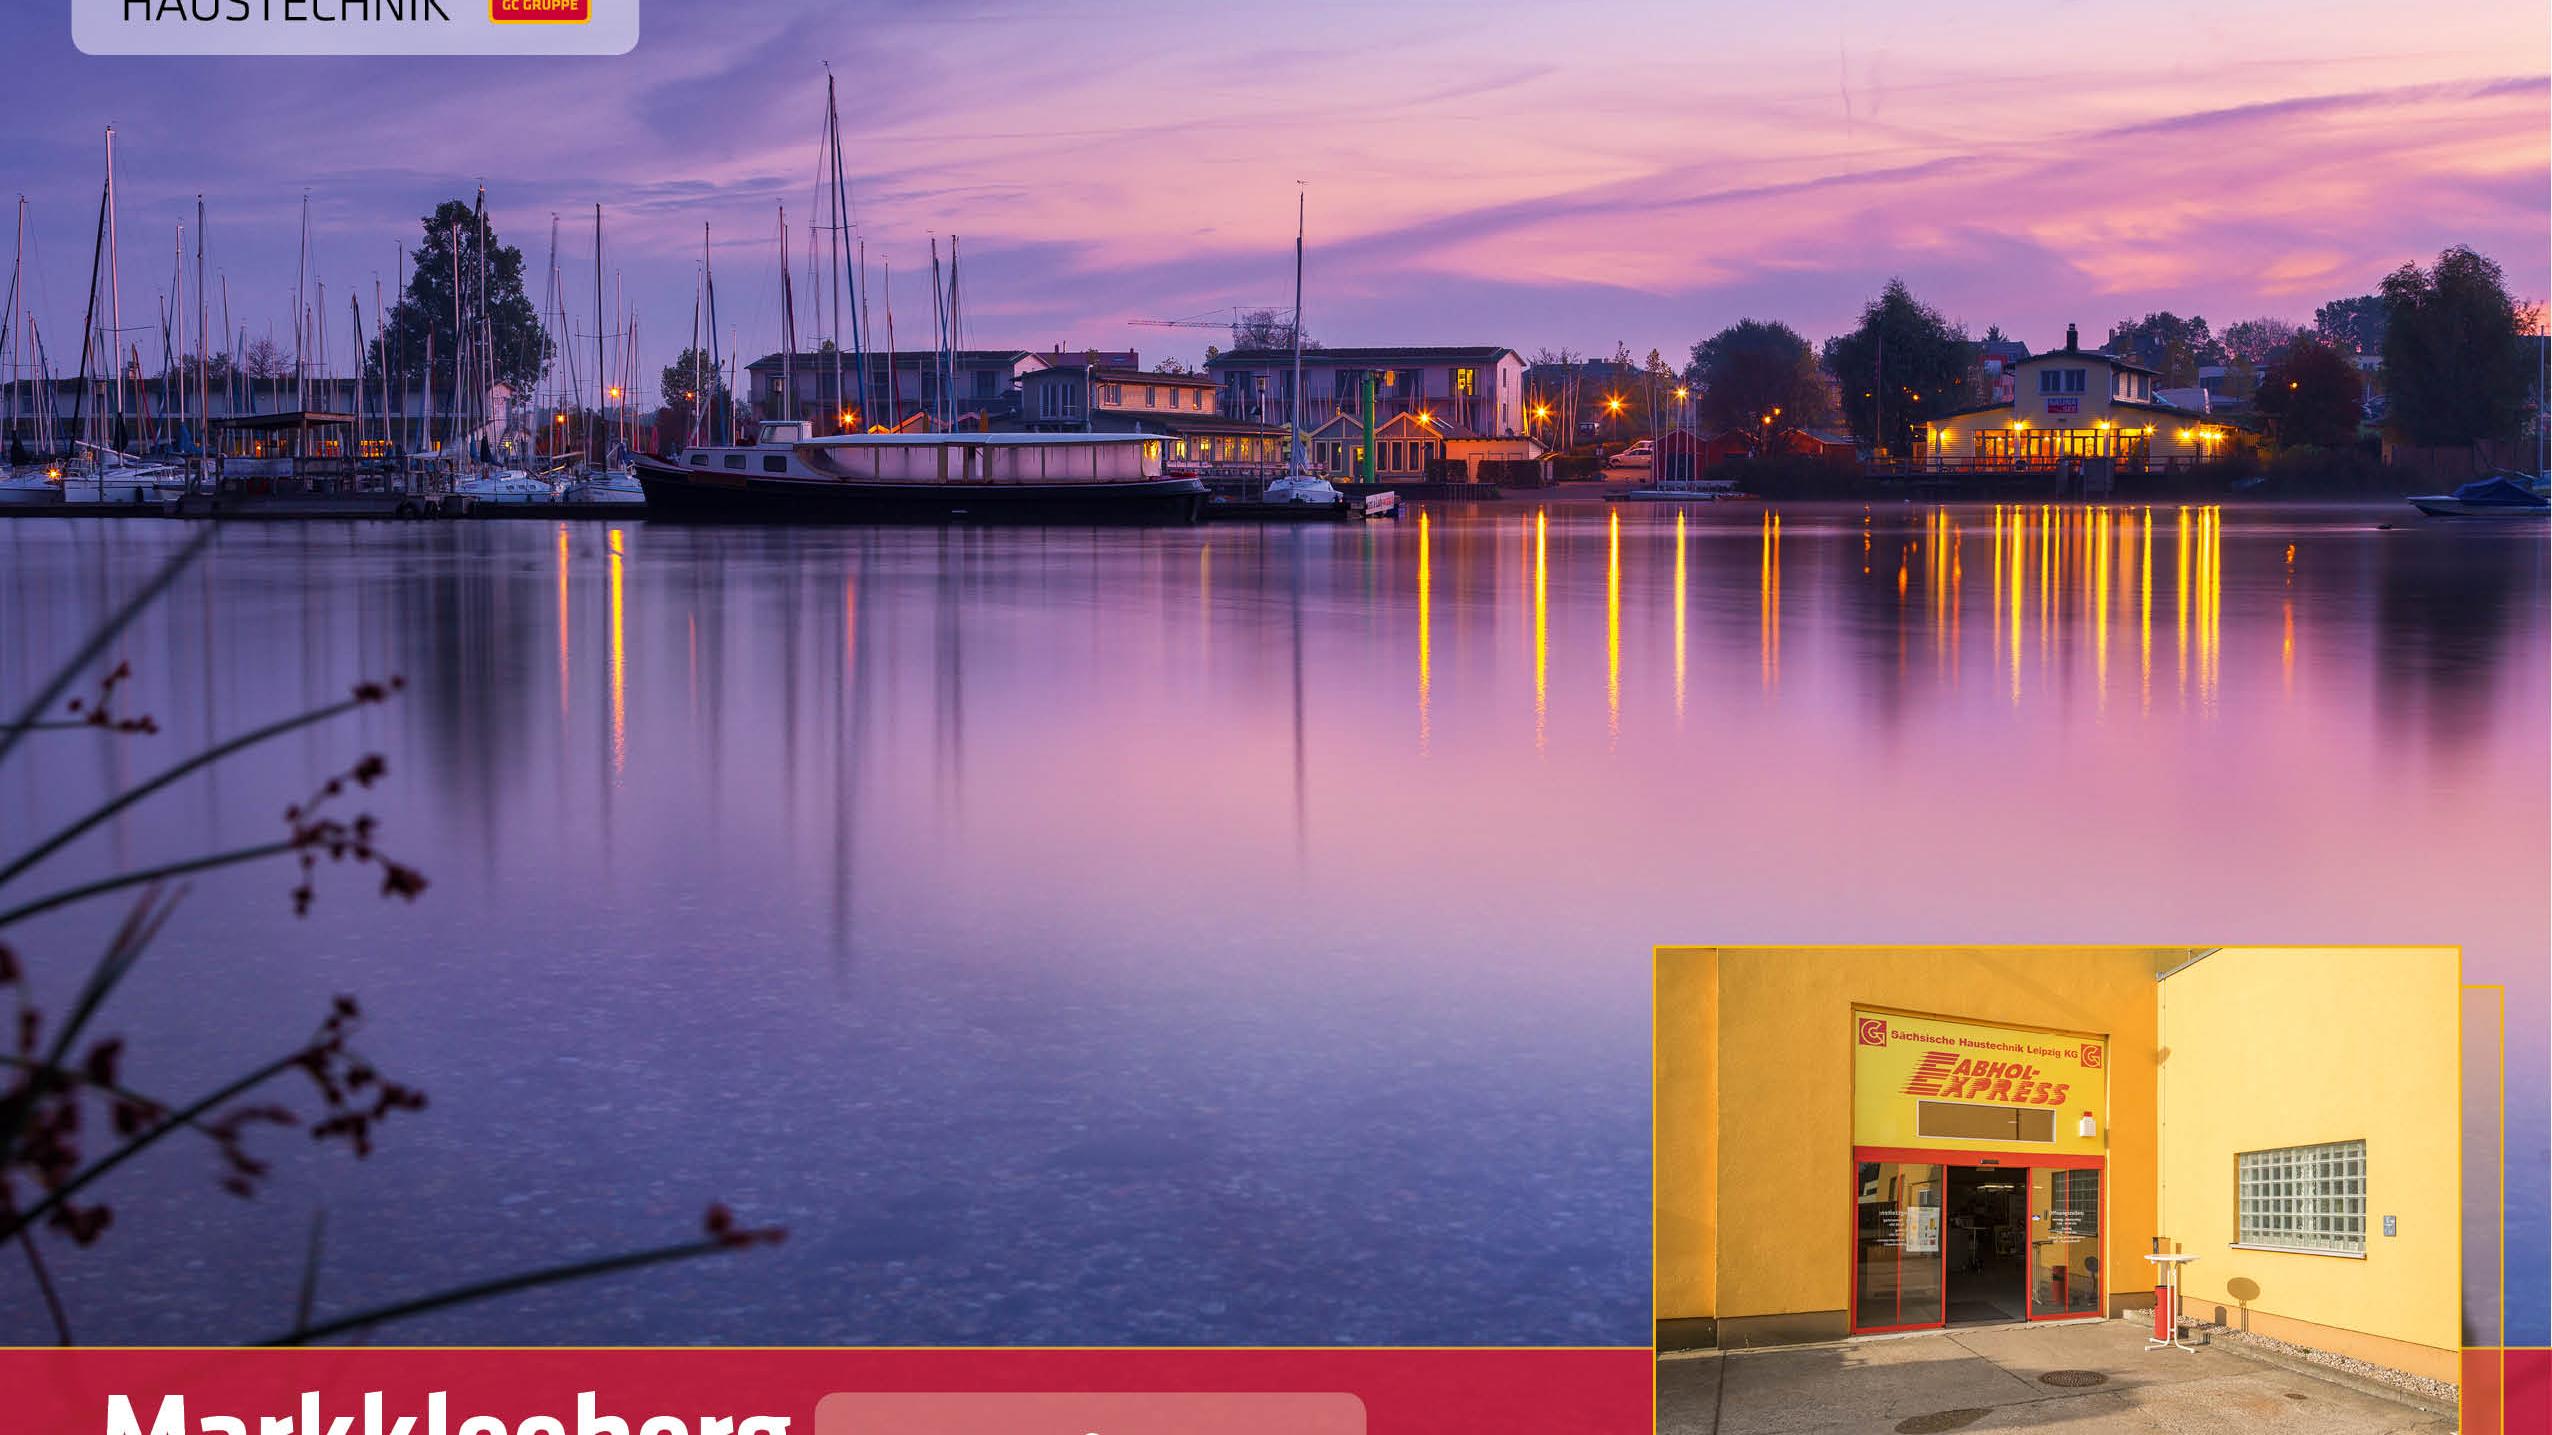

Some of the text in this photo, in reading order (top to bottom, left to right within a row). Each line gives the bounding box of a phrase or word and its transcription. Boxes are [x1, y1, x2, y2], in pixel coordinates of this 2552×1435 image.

[1891, 1030, 2078, 1059] Sächsische Haustechnik Leipzig KG
[1898, 1051, 2070, 1105] EXPRESS
[1952, 1058, 2040, 1080] ABHOL-
